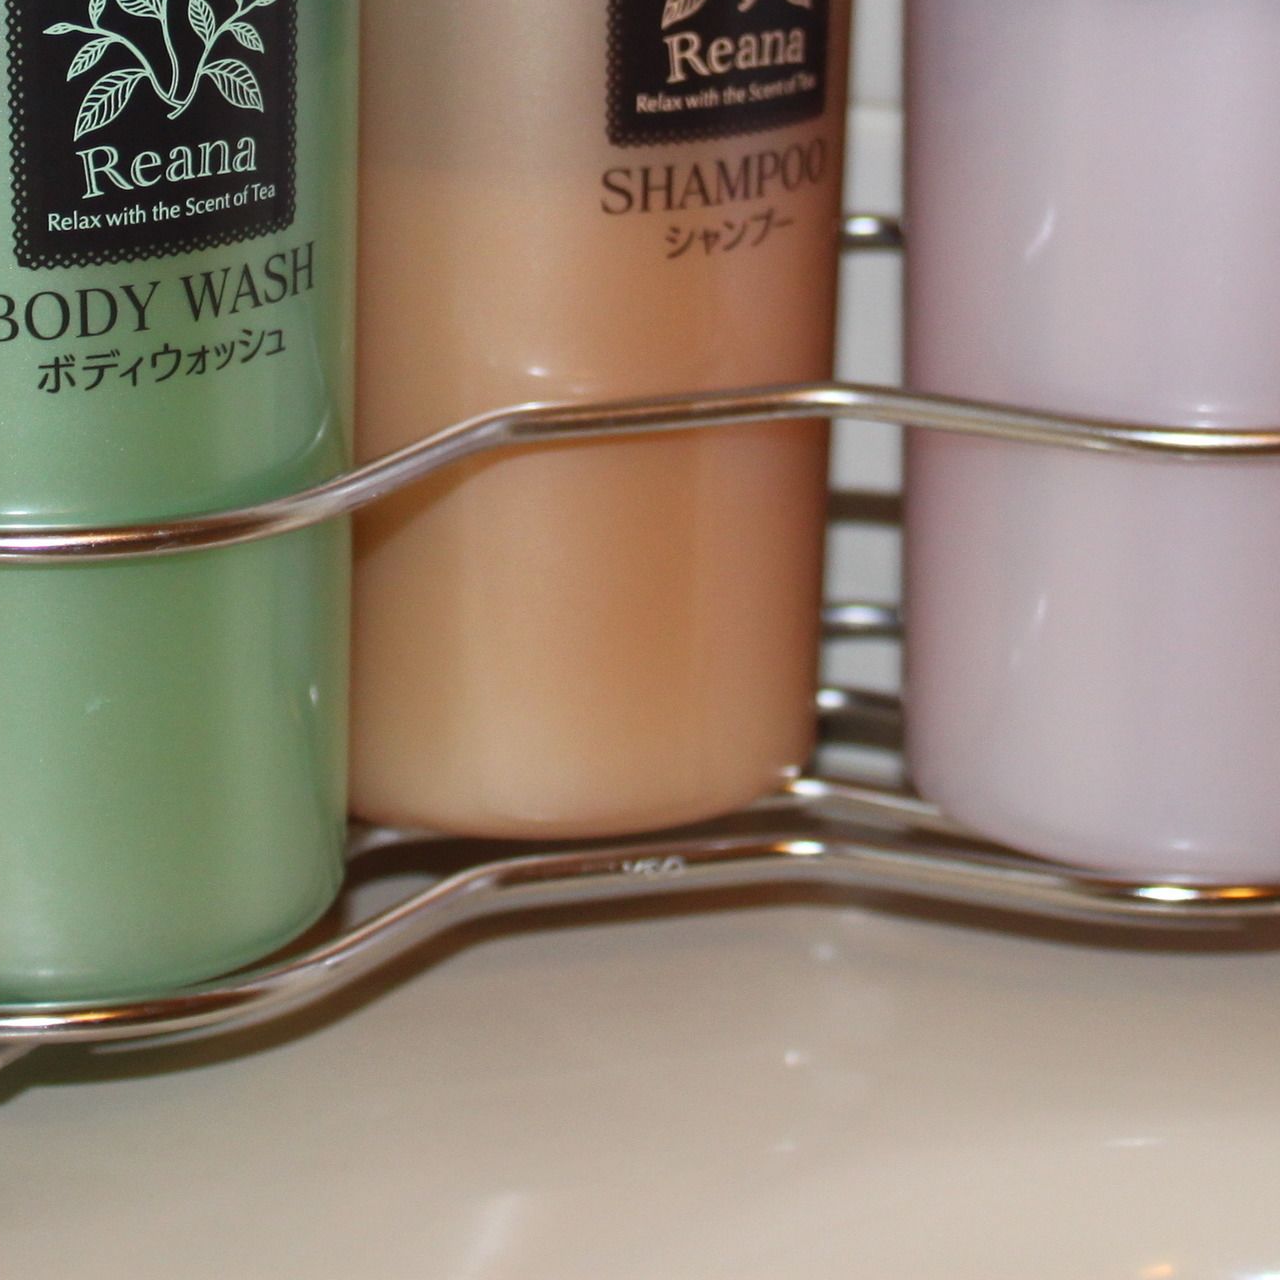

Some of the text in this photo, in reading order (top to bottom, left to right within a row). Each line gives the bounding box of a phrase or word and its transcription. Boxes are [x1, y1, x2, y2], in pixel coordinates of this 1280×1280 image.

[663, 28, 806, 84] Reana
[636, 92, 682, 114] Relax
[685, 87, 719, 109] with
[722, 85, 746, 106] the
[76, 135, 257, 200] Reana
[600, 138, 826, 216] SHAMPOO
[47, 182, 276, 232] Relax with the Scent of Tea
[665, 207, 795, 260] シャンプー
[179, 241, 316, 323] WASH
[37, 328, 287, 394] ボディウォッシュ
